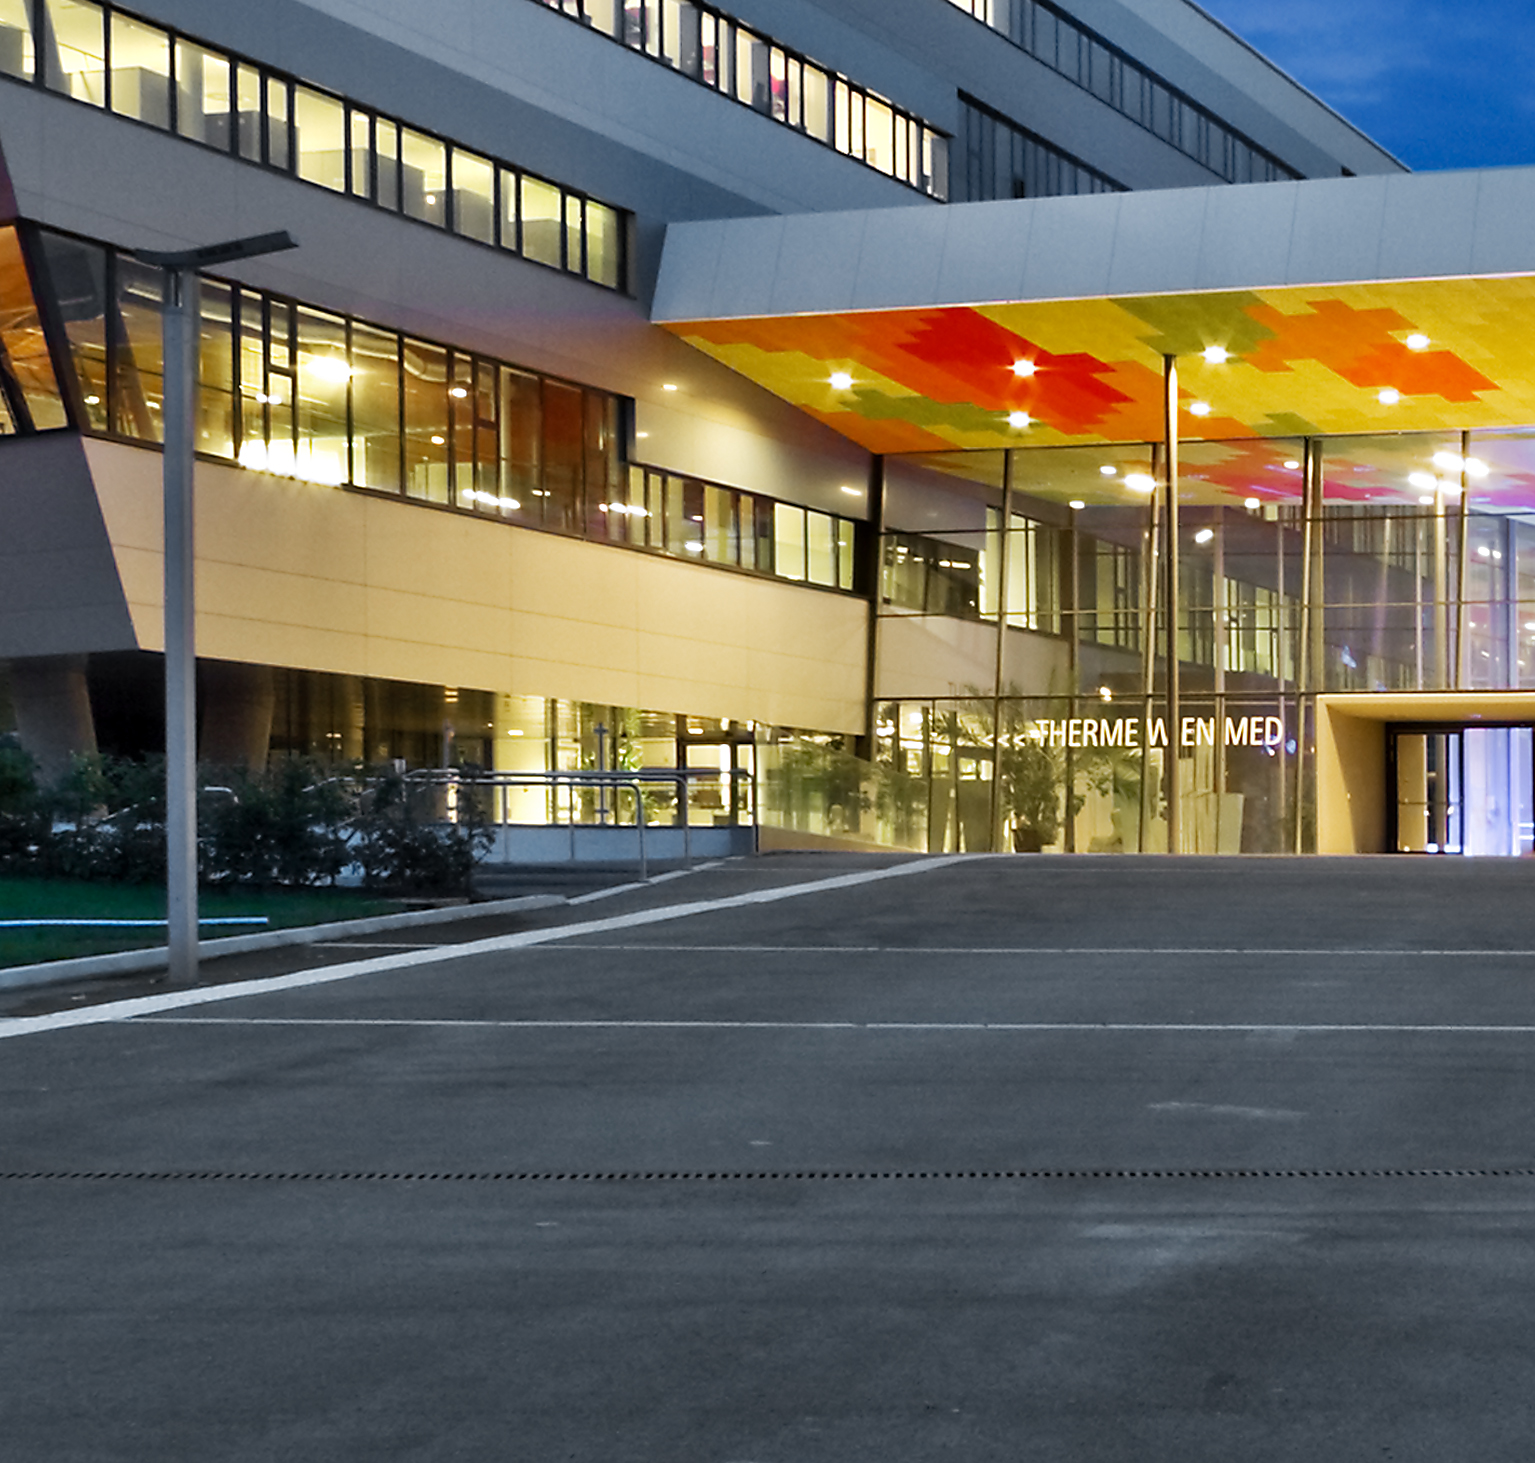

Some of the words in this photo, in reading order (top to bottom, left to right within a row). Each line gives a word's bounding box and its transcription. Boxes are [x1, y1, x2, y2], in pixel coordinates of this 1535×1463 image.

[1034, 718, 1139, 748] THERME
[1146, 716, 1215, 747] WEN
[1224, 716, 1283, 747] MED
